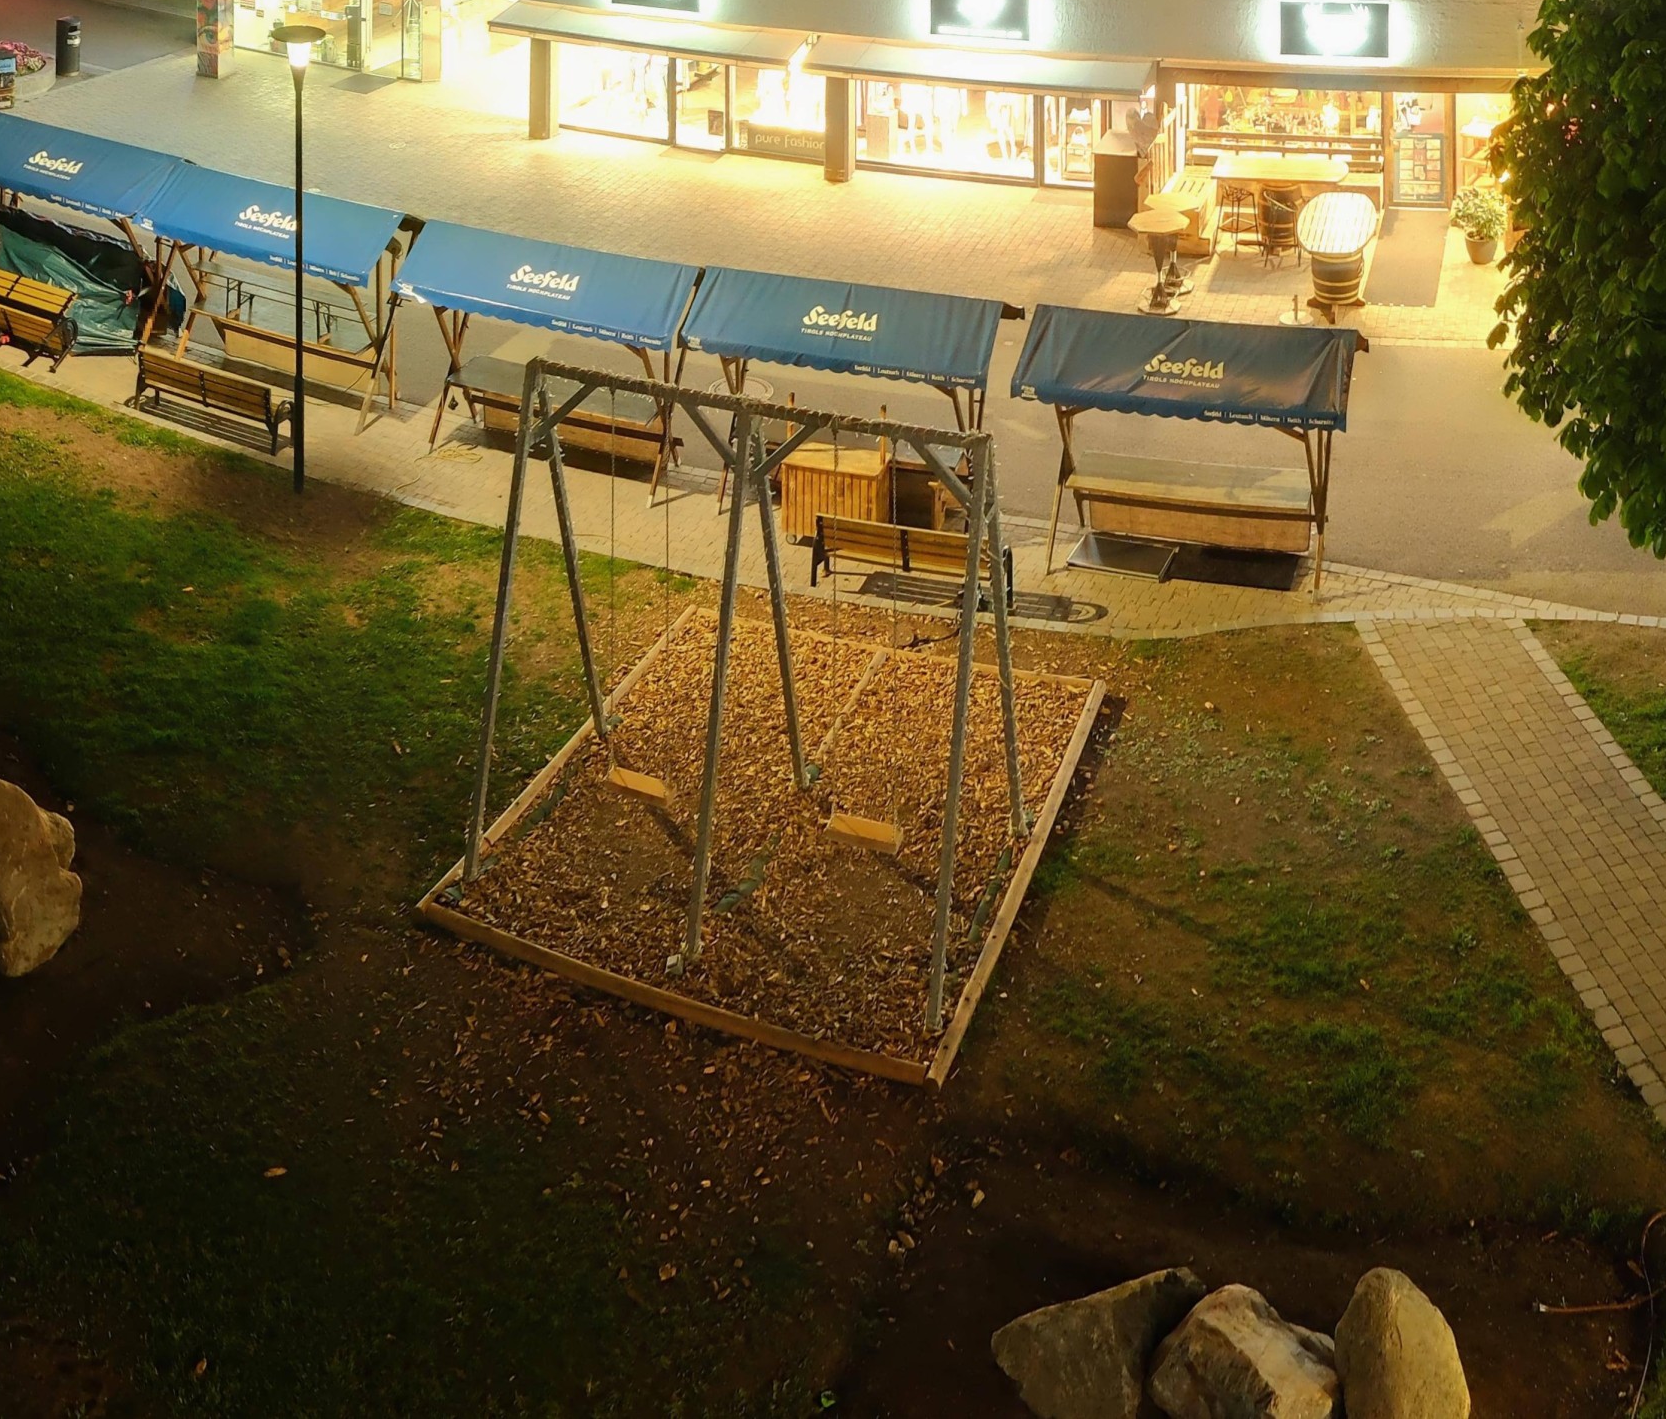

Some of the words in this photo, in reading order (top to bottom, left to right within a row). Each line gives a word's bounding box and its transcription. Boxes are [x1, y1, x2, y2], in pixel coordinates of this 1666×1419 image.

[755, 132, 781, 145] pure
[28, 150, 84, 175] Seefeld
[238, 204, 297, 232] Seefeld
[510, 264, 581, 292] Seefeld
[802, 304, 879, 333] Seefeld
[1144, 353, 1225, 380] Seefeld
